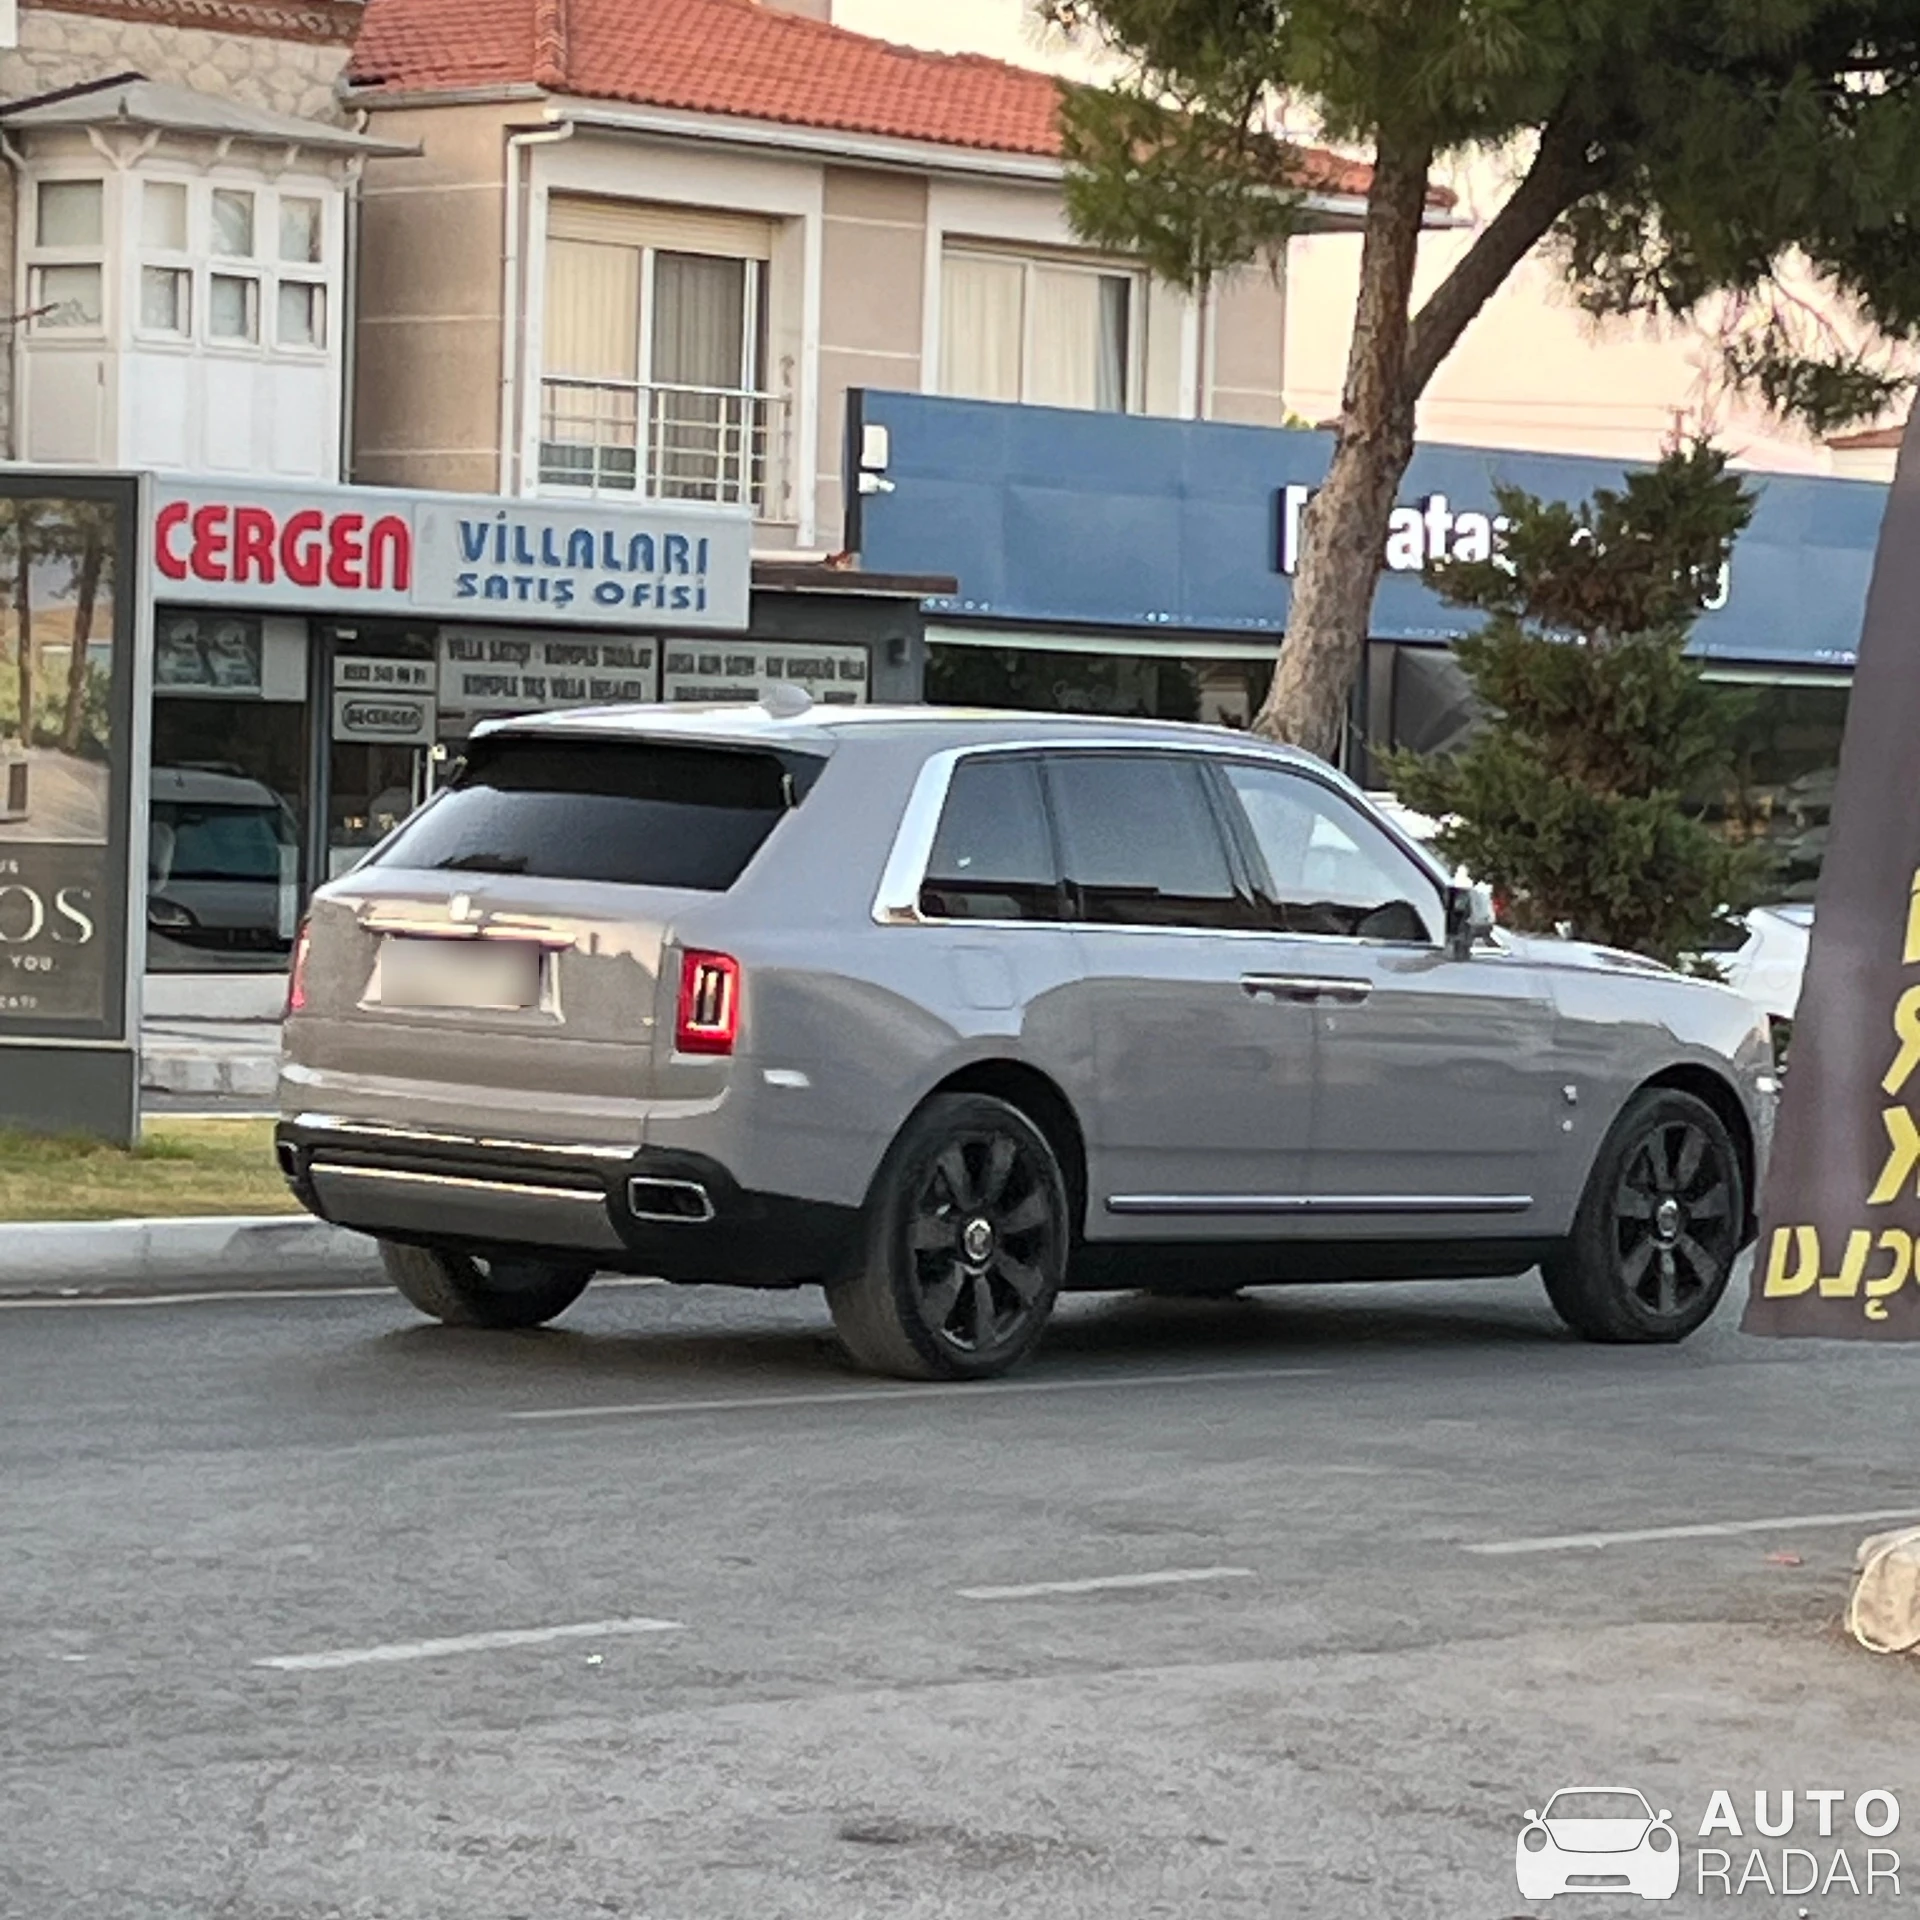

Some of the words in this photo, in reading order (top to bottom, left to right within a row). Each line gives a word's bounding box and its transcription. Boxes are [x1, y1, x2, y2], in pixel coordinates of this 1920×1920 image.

[155, 500, 411, 592] CERGEN
[459, 510, 709, 575] VİLLALARI
[456, 573, 574, 609] SATIŞ
[593, 575, 707, 612] OFİSİ
